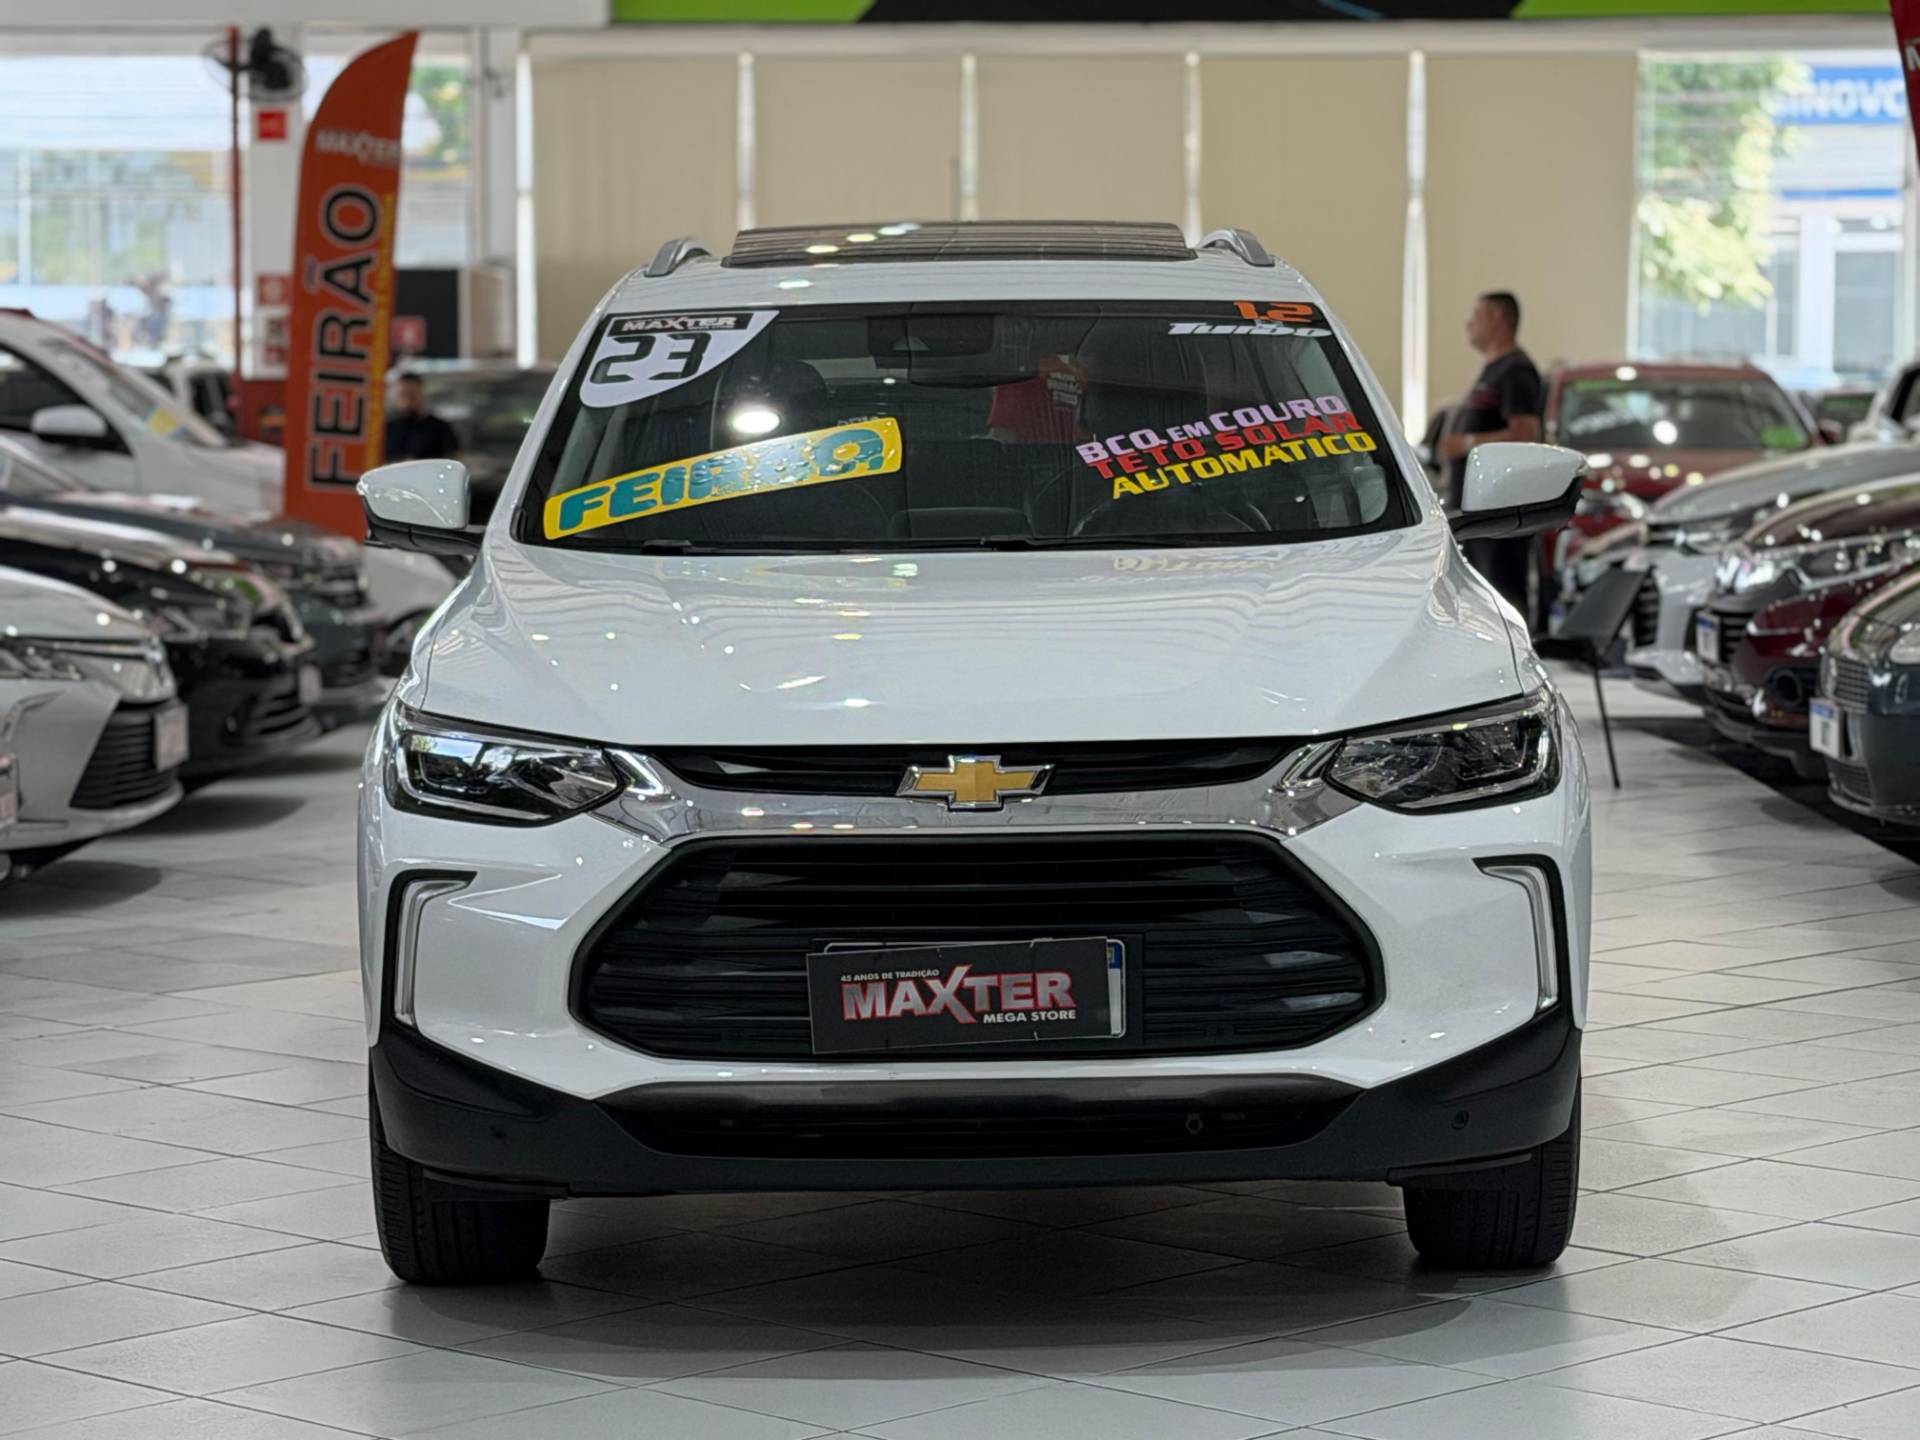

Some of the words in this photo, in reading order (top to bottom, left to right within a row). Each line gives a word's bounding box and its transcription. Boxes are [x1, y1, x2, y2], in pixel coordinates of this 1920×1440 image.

[622, 316, 737, 331] MAXTER
[1233, 300, 1313, 323] 1.2
[304, 184, 384, 491] FEIRÃO
[590, 332, 711, 384] 23
[1166, 421, 1211, 442] EM
[1209, 395, 1348, 433] COURO
[1088, 437, 1206, 480] TETO
[1214, 411, 1364, 451] SOLAR
[840, 964, 1077, 1024] MAXTER
[853, 972, 880, 982] ANOS
[881, 971, 894, 980] DE
[983, 1012, 1028, 1024] MEGA
[1030, 1009, 1077, 1021] STORE
